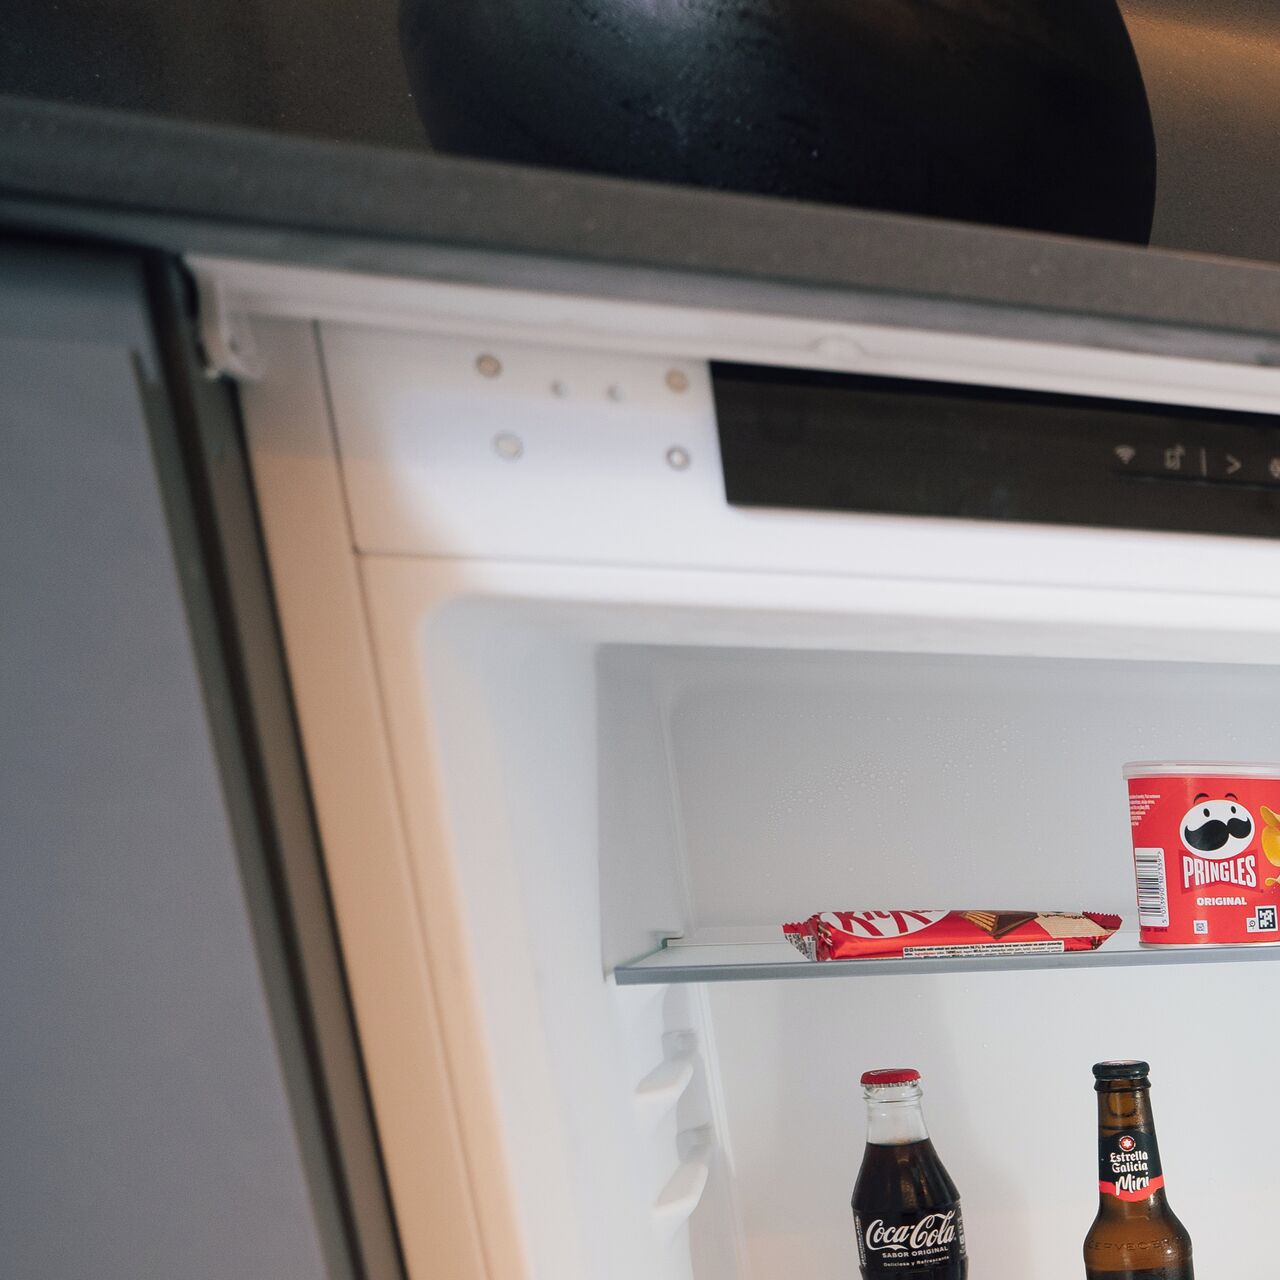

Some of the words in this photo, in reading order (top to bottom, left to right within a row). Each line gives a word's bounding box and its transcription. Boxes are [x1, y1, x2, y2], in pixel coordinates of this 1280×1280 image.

[1182, 855, 1257, 888] PRINGLES
[1196, 896, 1248, 907] ORIGINAL
[1110, 1150, 1149, 1163] Estrella
[1112, 1160, 1149, 1173] Galicia
[1115, 1172, 1150, 1196] Mini
[865, 1209, 956, 1251] Coca-Cola
[882, 1251, 910, 1259] SABOR
[911, 1245, 949, 1257] ORIGINAL
